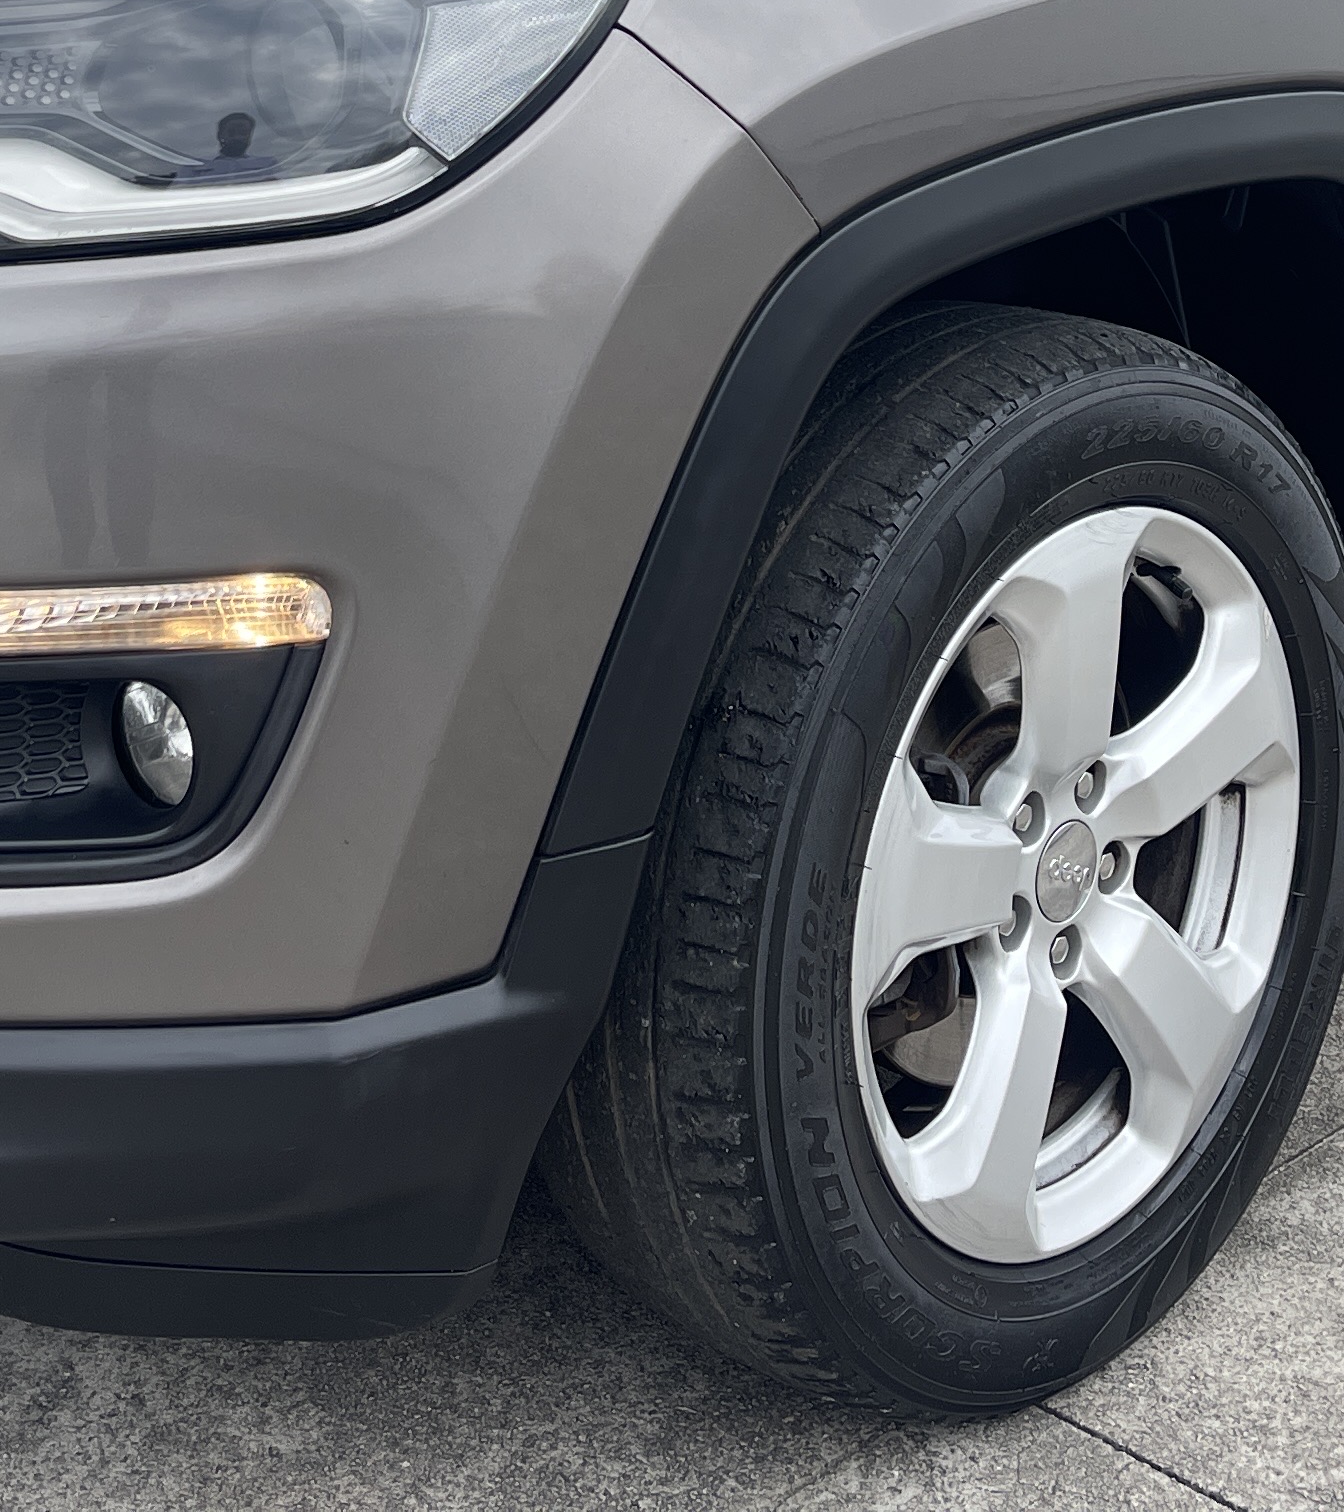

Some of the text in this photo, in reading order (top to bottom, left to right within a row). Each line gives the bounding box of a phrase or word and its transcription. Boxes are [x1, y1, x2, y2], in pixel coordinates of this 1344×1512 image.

[1080, 415, 1226, 460] 225/60
[1229, 440, 1292, 495] R17
[794, 861, 828, 1082] VERDE
[800, 1117, 1003, 1373] SCORPION
